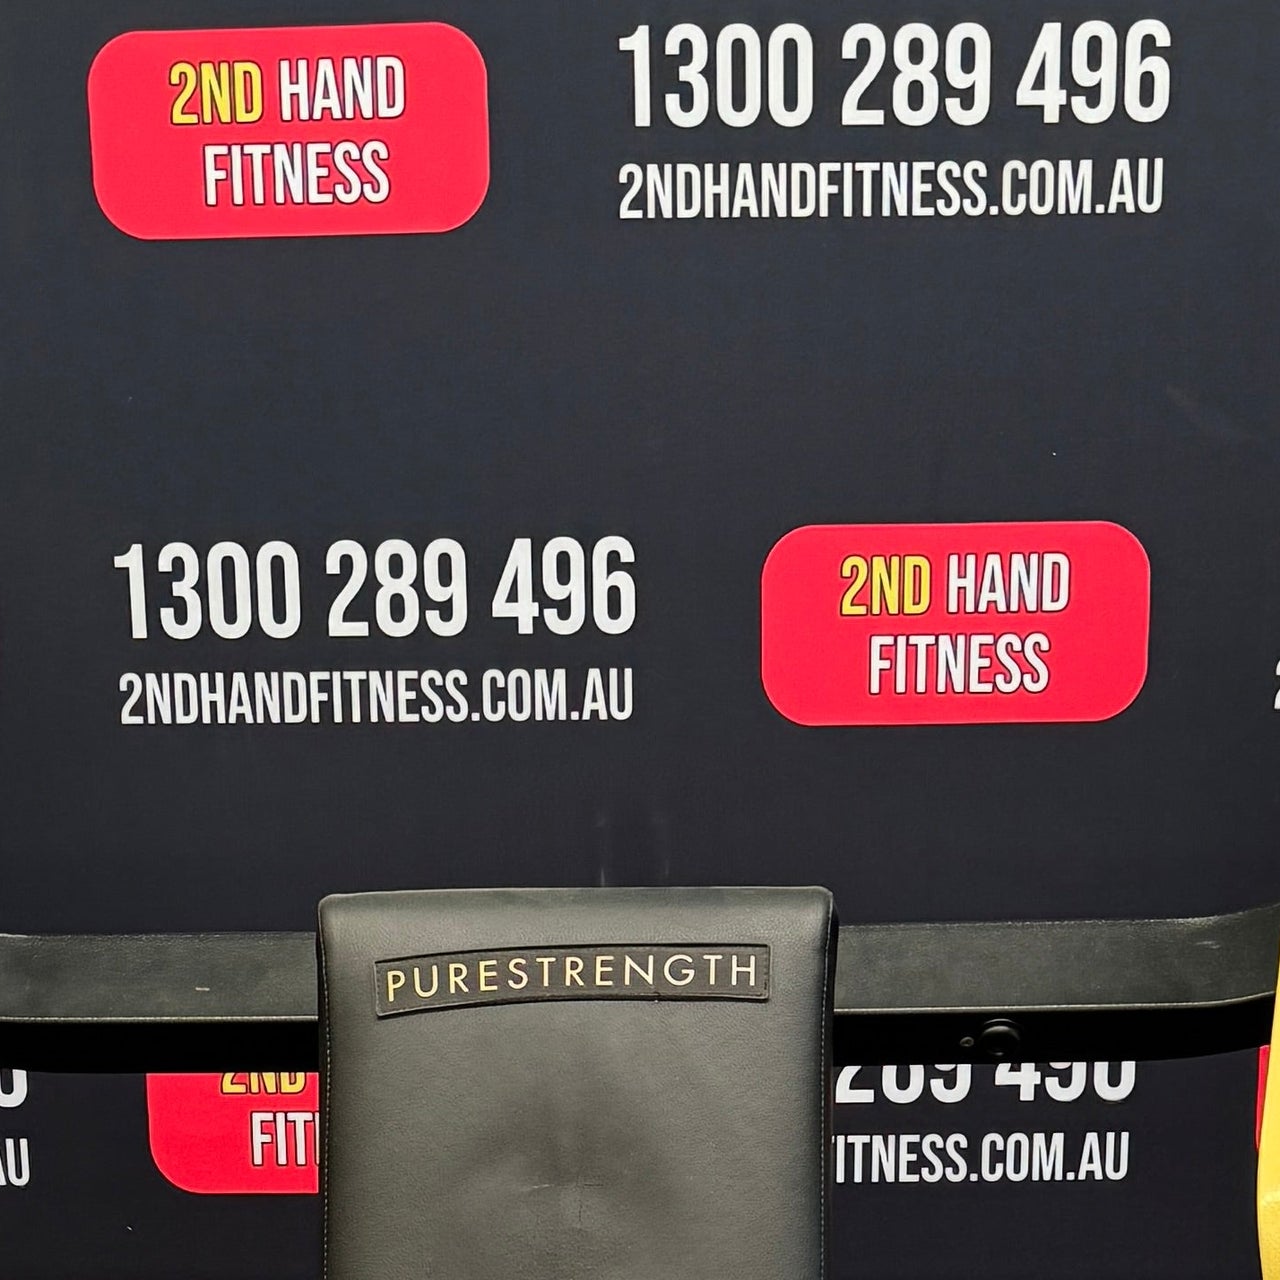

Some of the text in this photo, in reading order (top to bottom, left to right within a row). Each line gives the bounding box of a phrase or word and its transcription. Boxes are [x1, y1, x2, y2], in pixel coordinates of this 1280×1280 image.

[171, 57, 404, 123] 2ND HAND
[619, 19, 1171, 127] 1300 289 496
[205, 141, 389, 205] FITNESS
[619, 158, 1163, 219] 2NDHANDFITNESS.COM.AU
[114, 536, 635, 639] 1300 289 496
[842, 553, 1069, 614] 2ND HAND
[871, 633, 1049, 693] FITNESS
[120, 668, 632, 724] 2NDHANDFITNESS.COM.AU
[386, 954, 757, 1002] PURESTRENGTH
[252, 1112, 319, 1164] FIT
